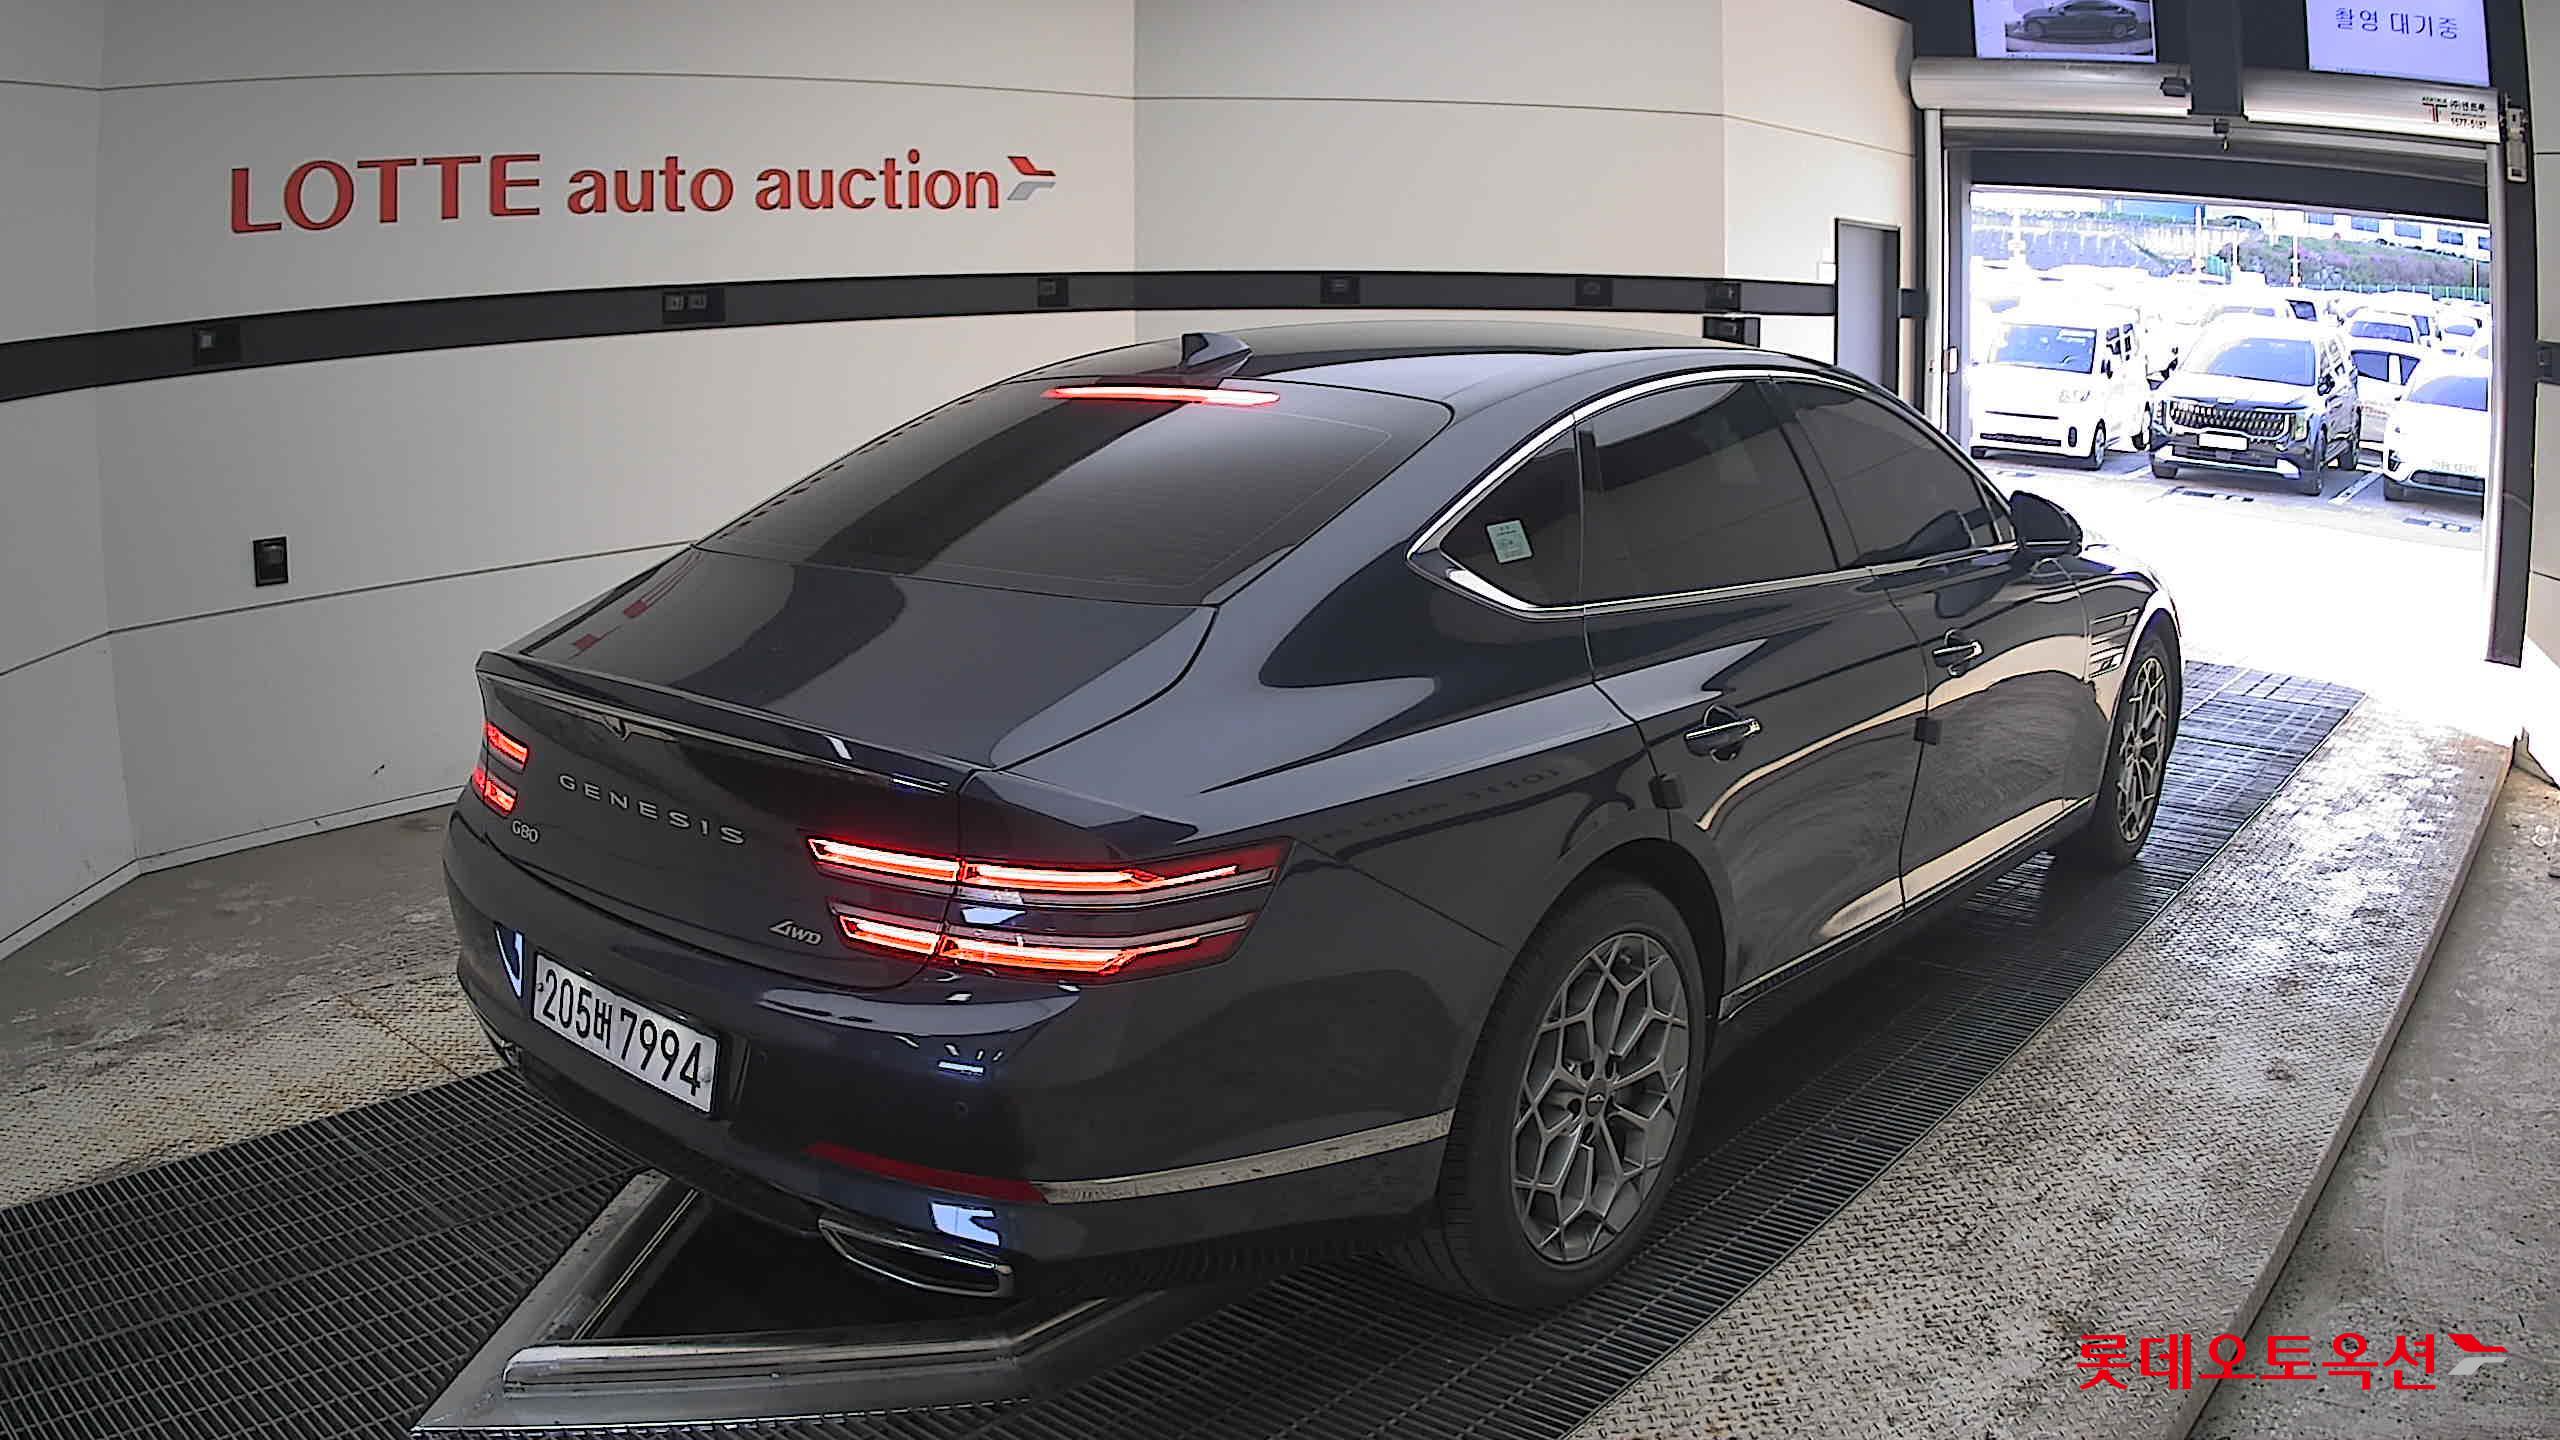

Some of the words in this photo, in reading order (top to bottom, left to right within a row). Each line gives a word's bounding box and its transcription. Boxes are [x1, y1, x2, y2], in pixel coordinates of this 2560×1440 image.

[2336, 7, 2379, 32] 촬영
[2390, 12, 2457, 40] 대기중
[231, 155, 540, 234] LOTTE
[567, 156, 735, 215] auto
[755, 148, 1000, 212] auction
[512, 819, 538, 843] G80
[559, 774, 745, 845] GENESIS
